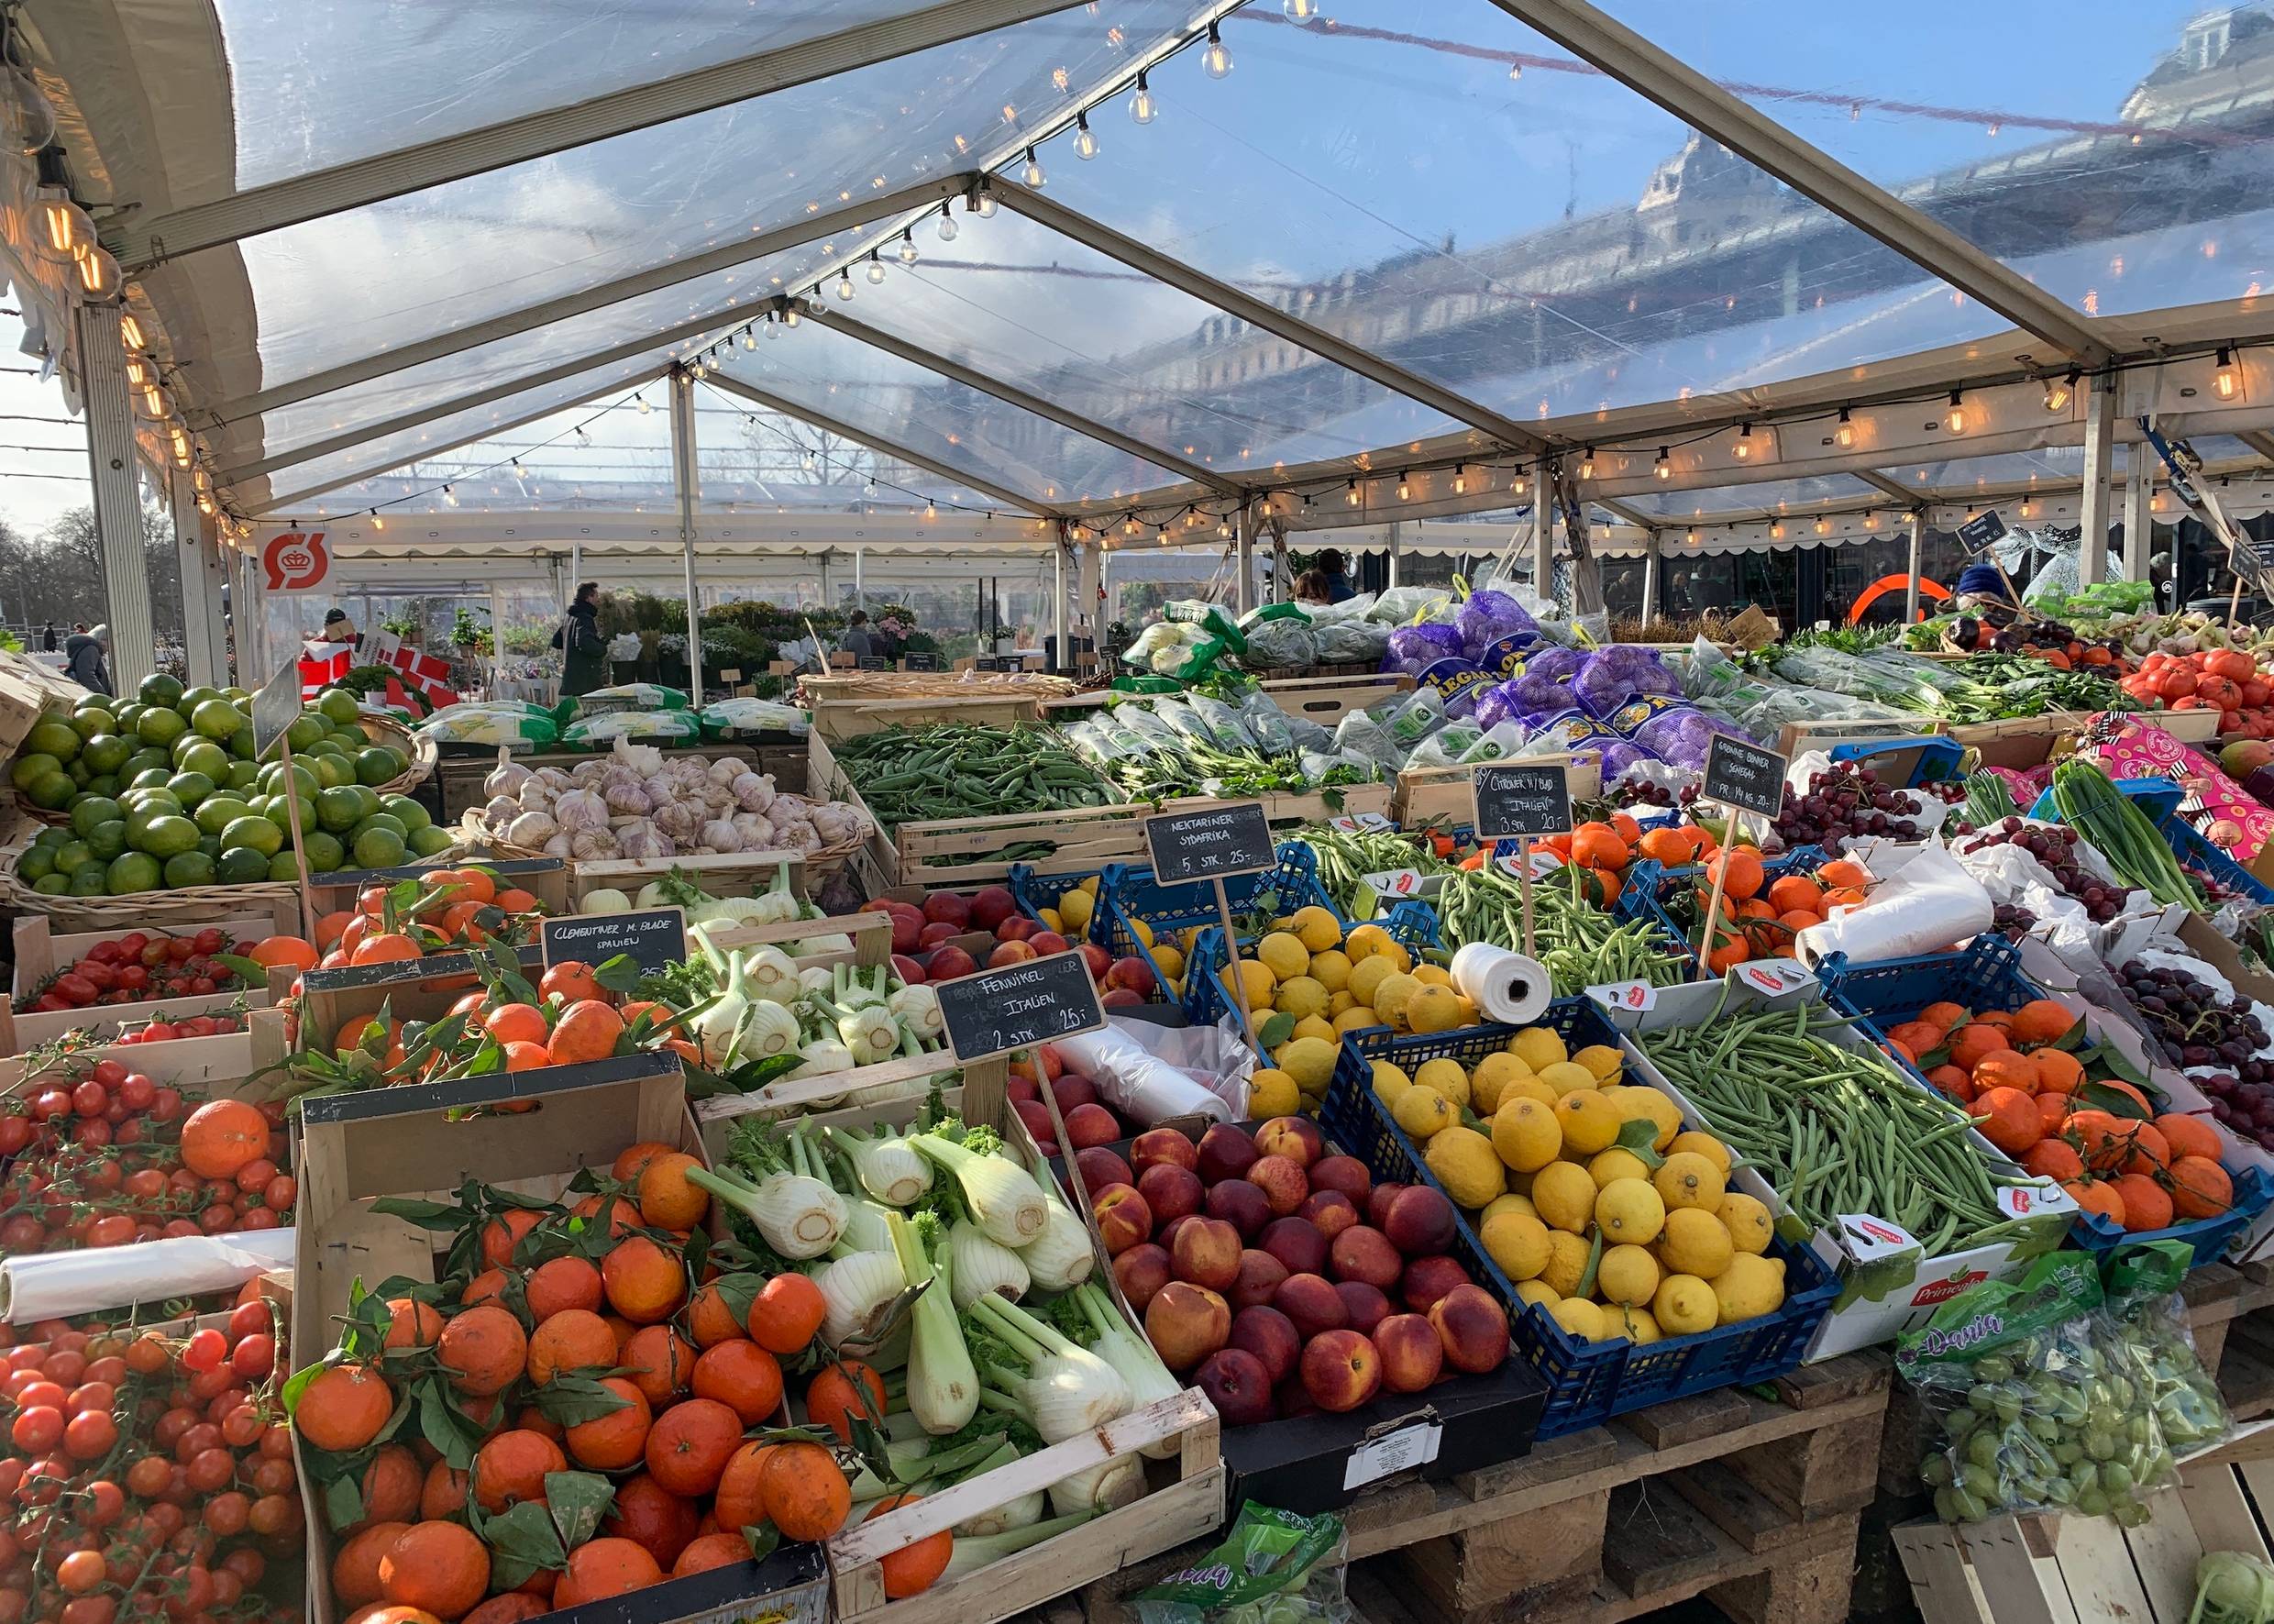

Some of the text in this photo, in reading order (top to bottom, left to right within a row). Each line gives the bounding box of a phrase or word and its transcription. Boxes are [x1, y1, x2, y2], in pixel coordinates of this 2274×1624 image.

[1500, 816, 1510, 833] 3
[1182, 856, 1191, 872] 5
[993, 1030, 1005, 1050] 2
